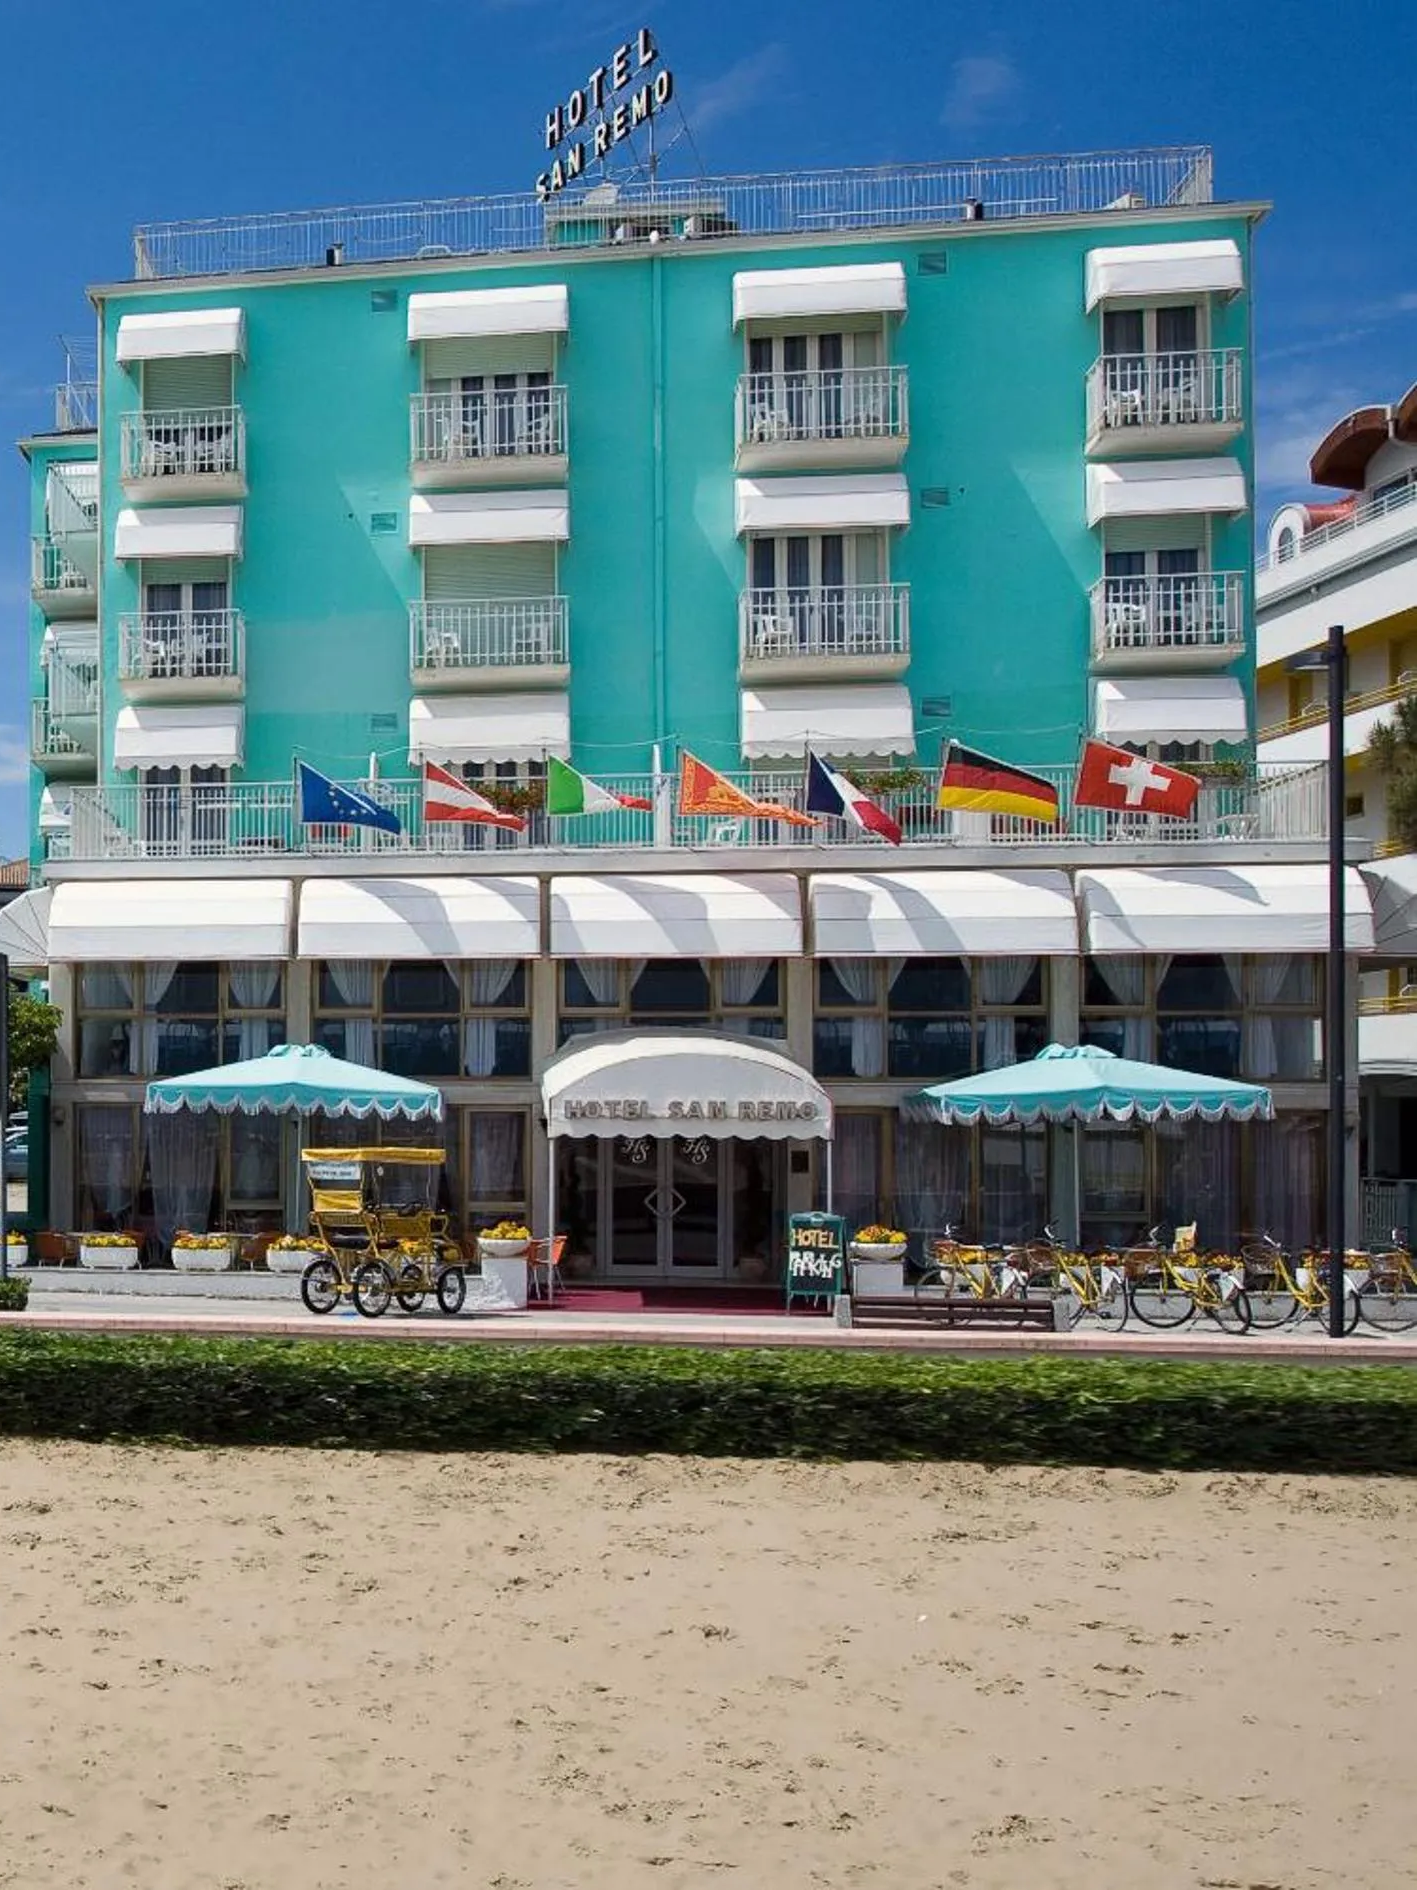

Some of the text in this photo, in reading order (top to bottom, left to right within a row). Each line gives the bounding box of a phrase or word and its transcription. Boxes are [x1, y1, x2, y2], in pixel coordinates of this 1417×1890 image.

[545, 28, 657, 150] HOTEL
[535, 70, 673, 202] SAN REMO
[564, 1100, 819, 1121] HOTEL SAN REMO
[790, 1227, 840, 1249] HOTEL
